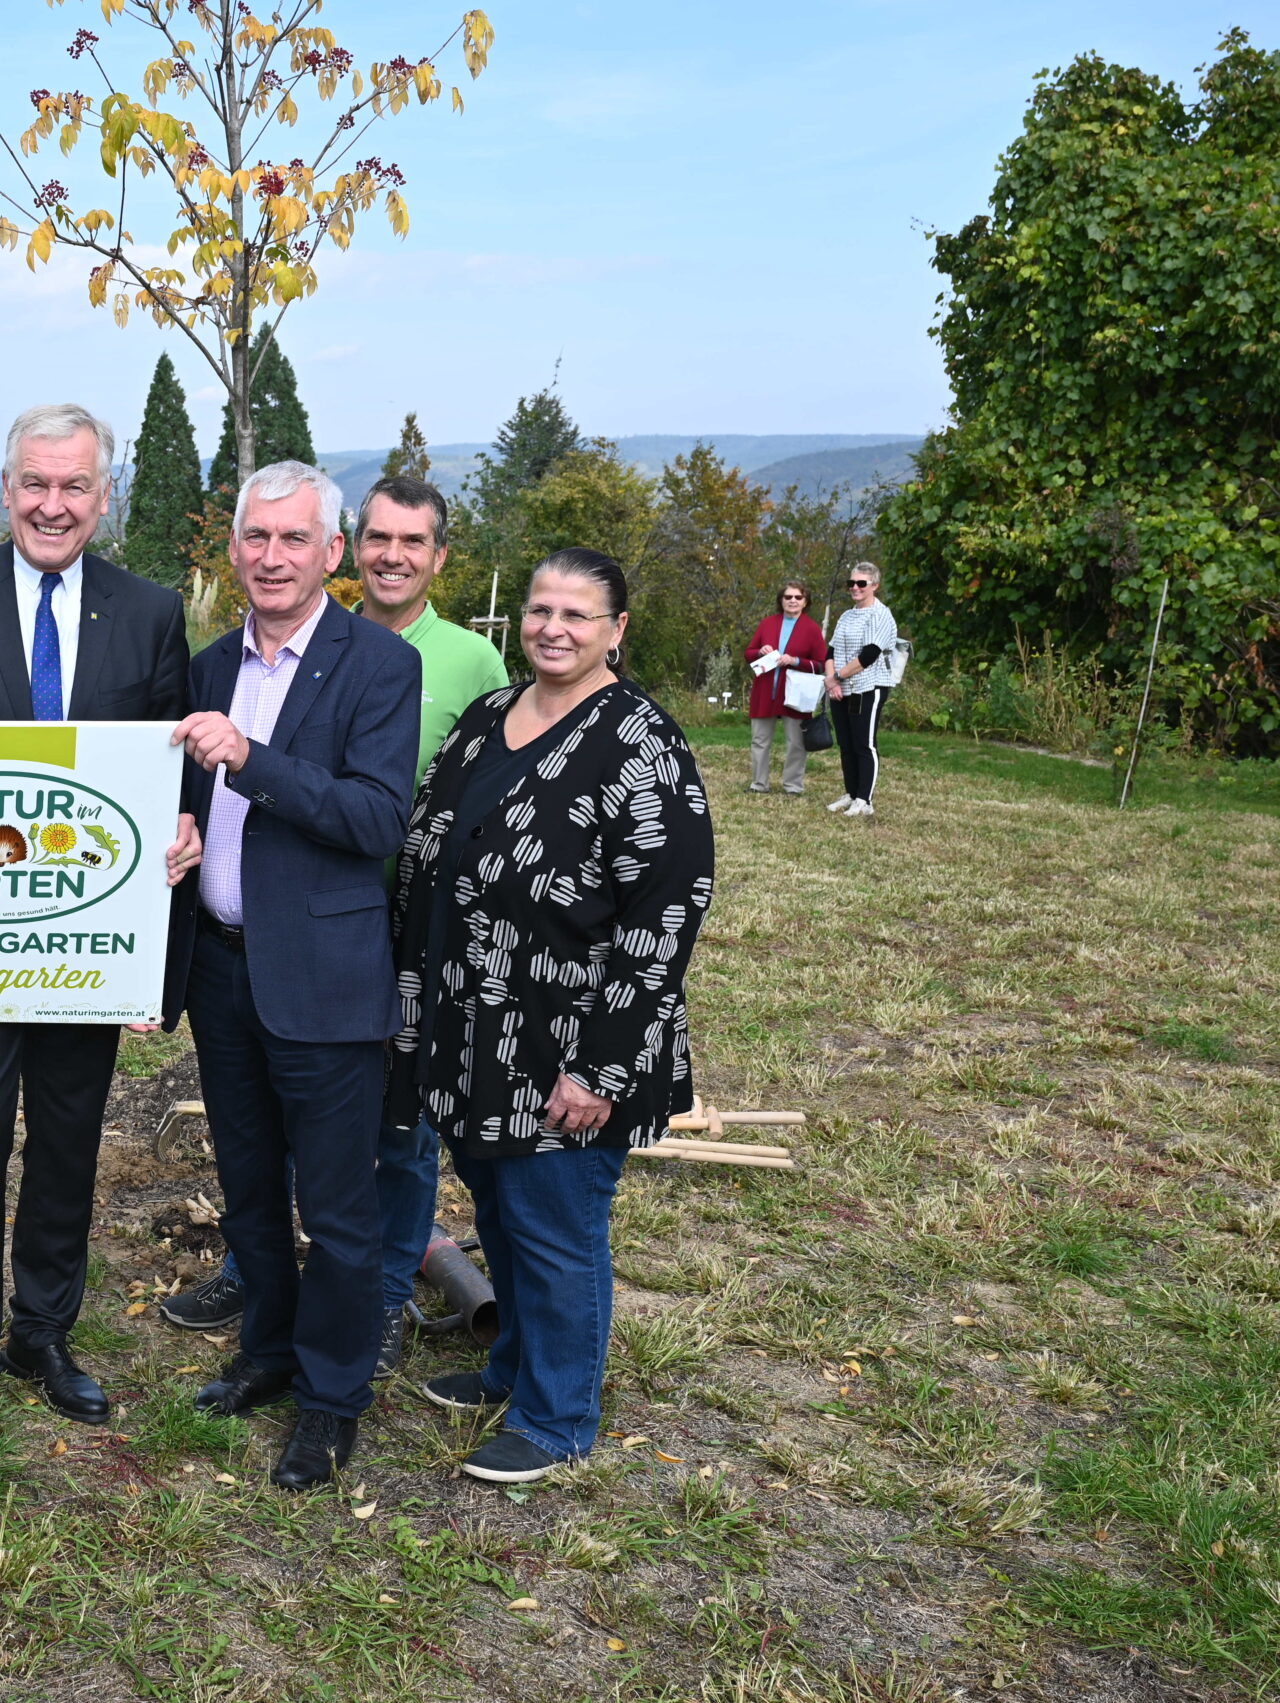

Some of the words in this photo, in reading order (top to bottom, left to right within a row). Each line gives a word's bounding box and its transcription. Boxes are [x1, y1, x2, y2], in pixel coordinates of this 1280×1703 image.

[77, 803, 102, 820] im
[17, 907, 44, 918] gesund
[35, 1009, 146, 1017] www.naturimgarten.at
